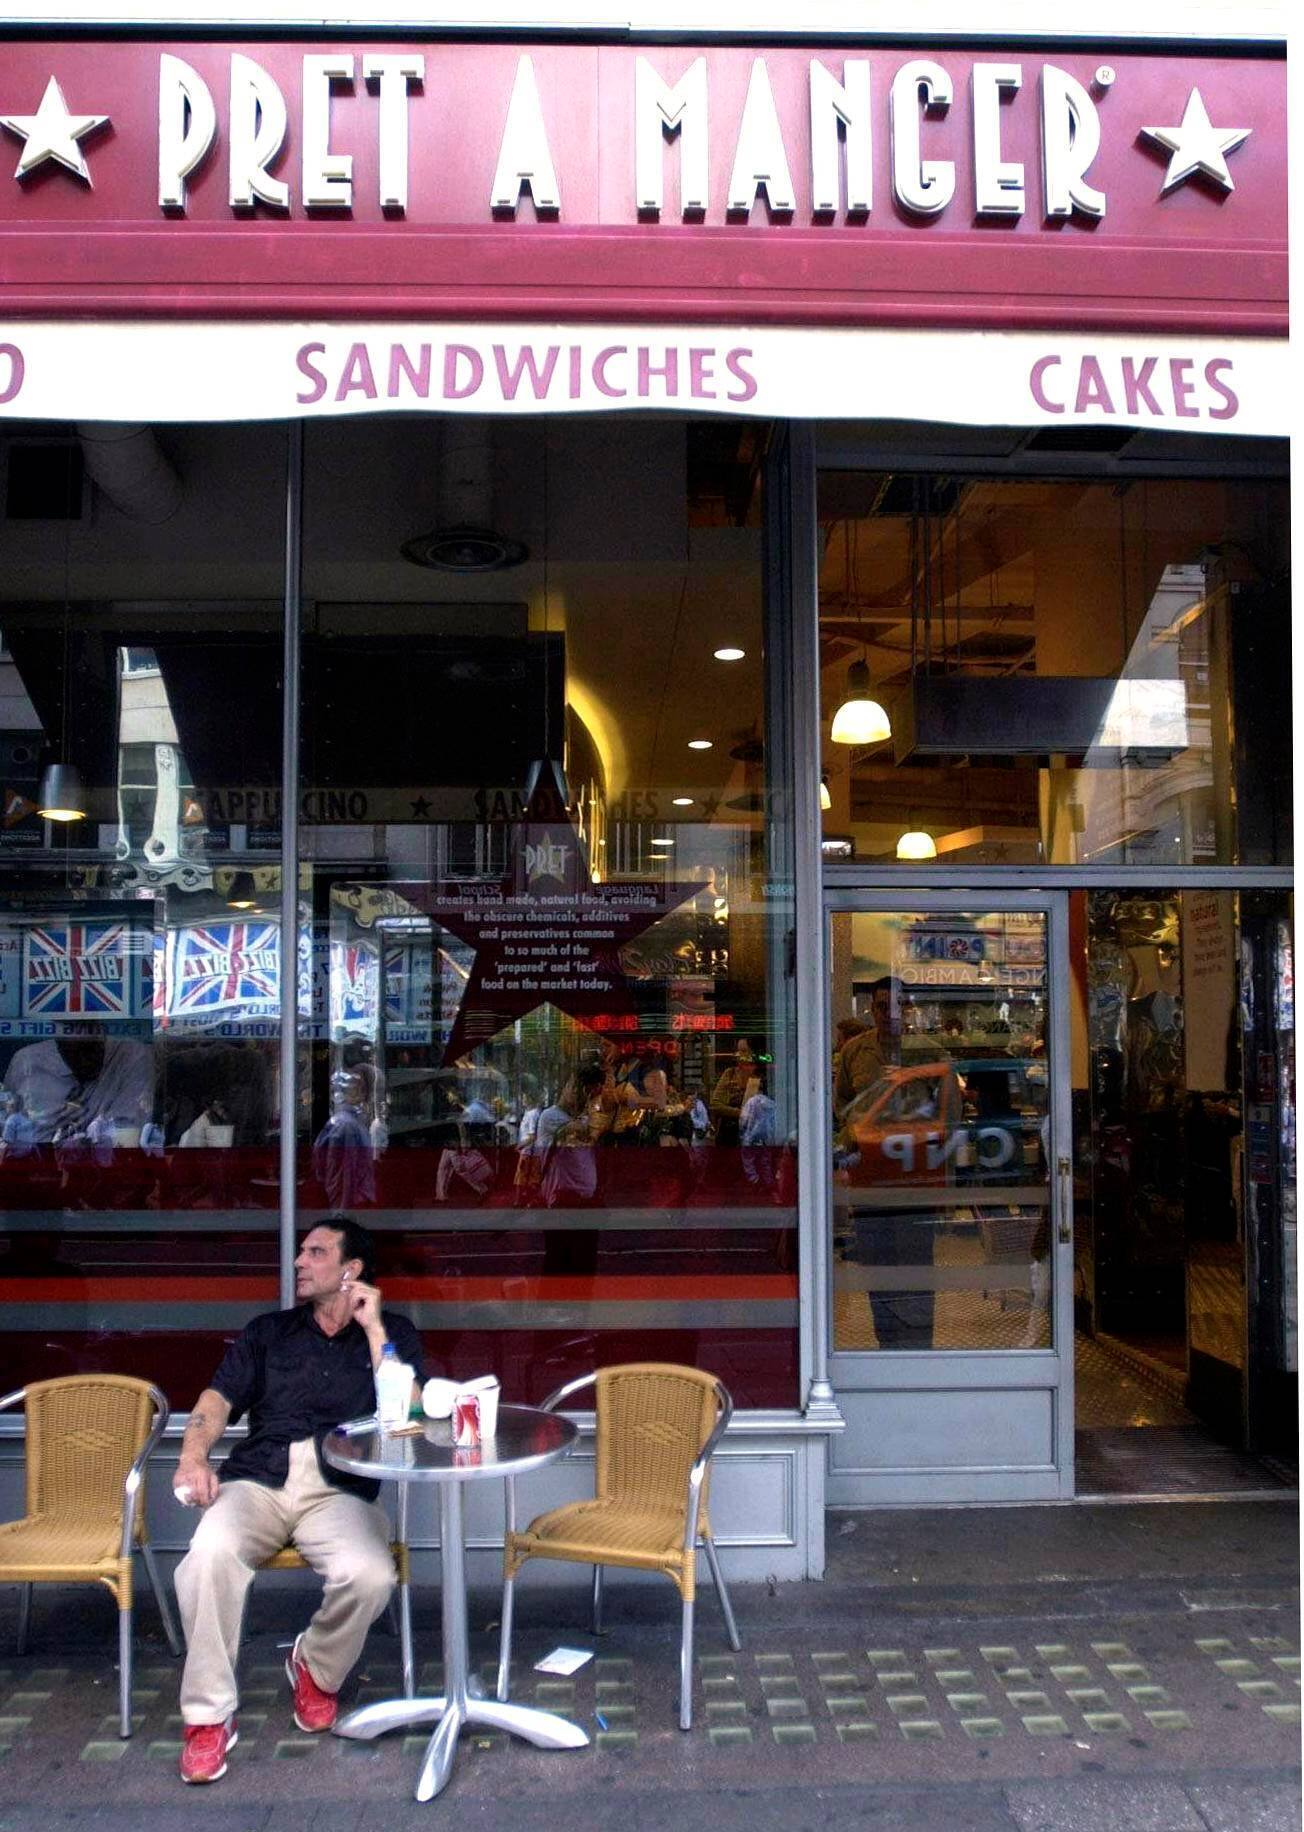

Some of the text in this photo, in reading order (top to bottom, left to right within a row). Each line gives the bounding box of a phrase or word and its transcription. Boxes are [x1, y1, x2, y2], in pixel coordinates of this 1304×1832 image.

[158, 53, 425, 212] PRET
[490, 54, 562, 218] A
[634, 56, 1106, 222] MANGER
[295, 342, 759, 405] SANDWICHES
[1028, 355, 1240, 421] CAKES
[525, 844, 568, 874] PRET
[437, 895, 474, 905] creates
[476, 892, 503, 905] hand
[541, 893, 578, 905] natural
[611, 894, 657, 908] avoiding
[464, 911, 481, 922] the
[483, 910, 524, 922] obscure
[582, 910, 631, 922] additives
[479, 927, 615, 941] and preservatives common
[504, 944, 590, 956] to so much of the
[550, 961, 571, 973] and
[481, 978, 504, 990] food
[506, 980, 520, 990] on
[522, 979, 539, 990] the
[541, 978, 578, 990] market
